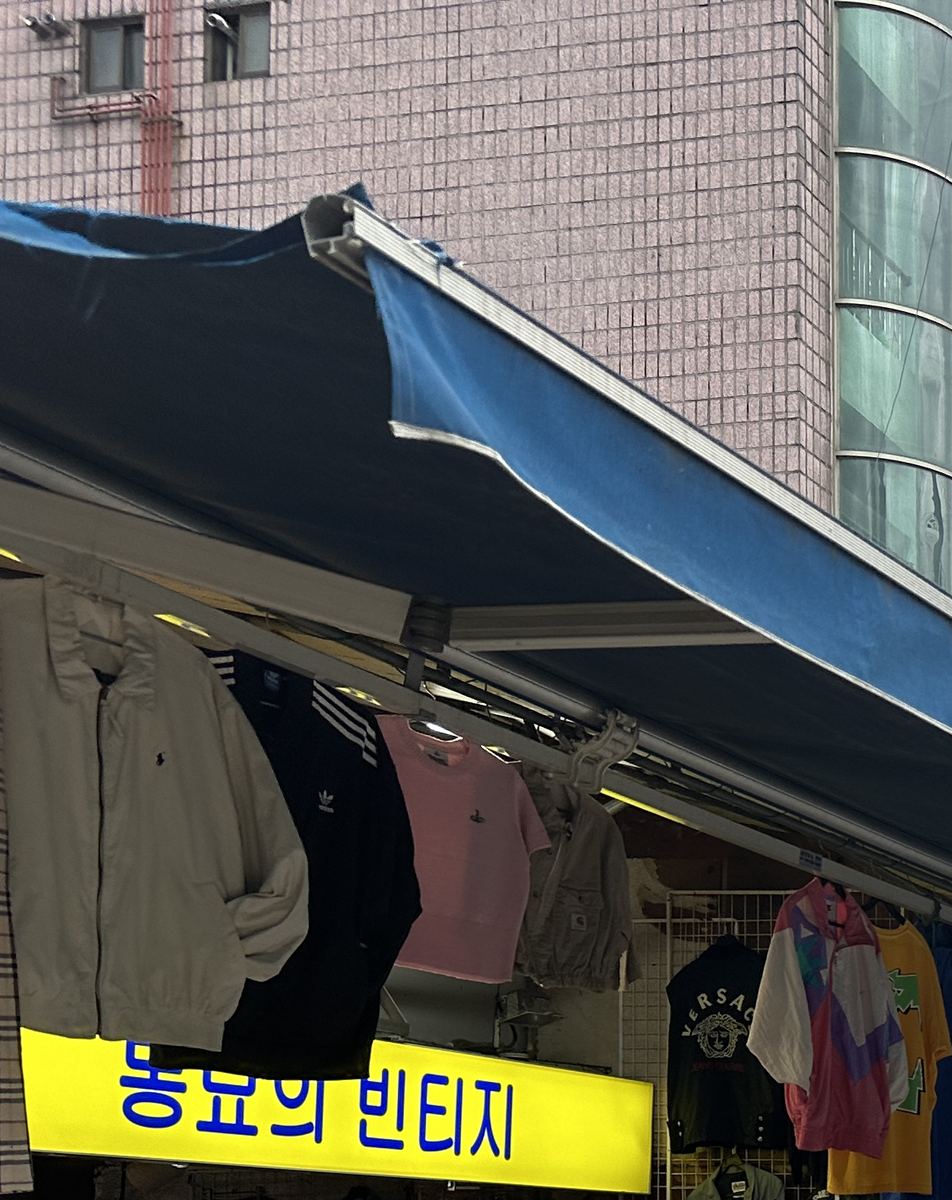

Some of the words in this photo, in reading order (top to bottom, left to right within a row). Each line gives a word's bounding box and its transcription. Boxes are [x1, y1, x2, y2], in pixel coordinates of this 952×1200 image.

[681, 988, 754, 1036] VERSAC
[119, 1040, 325, 1144] 동묘의
[358, 1069, 513, 1160] 빈티지
